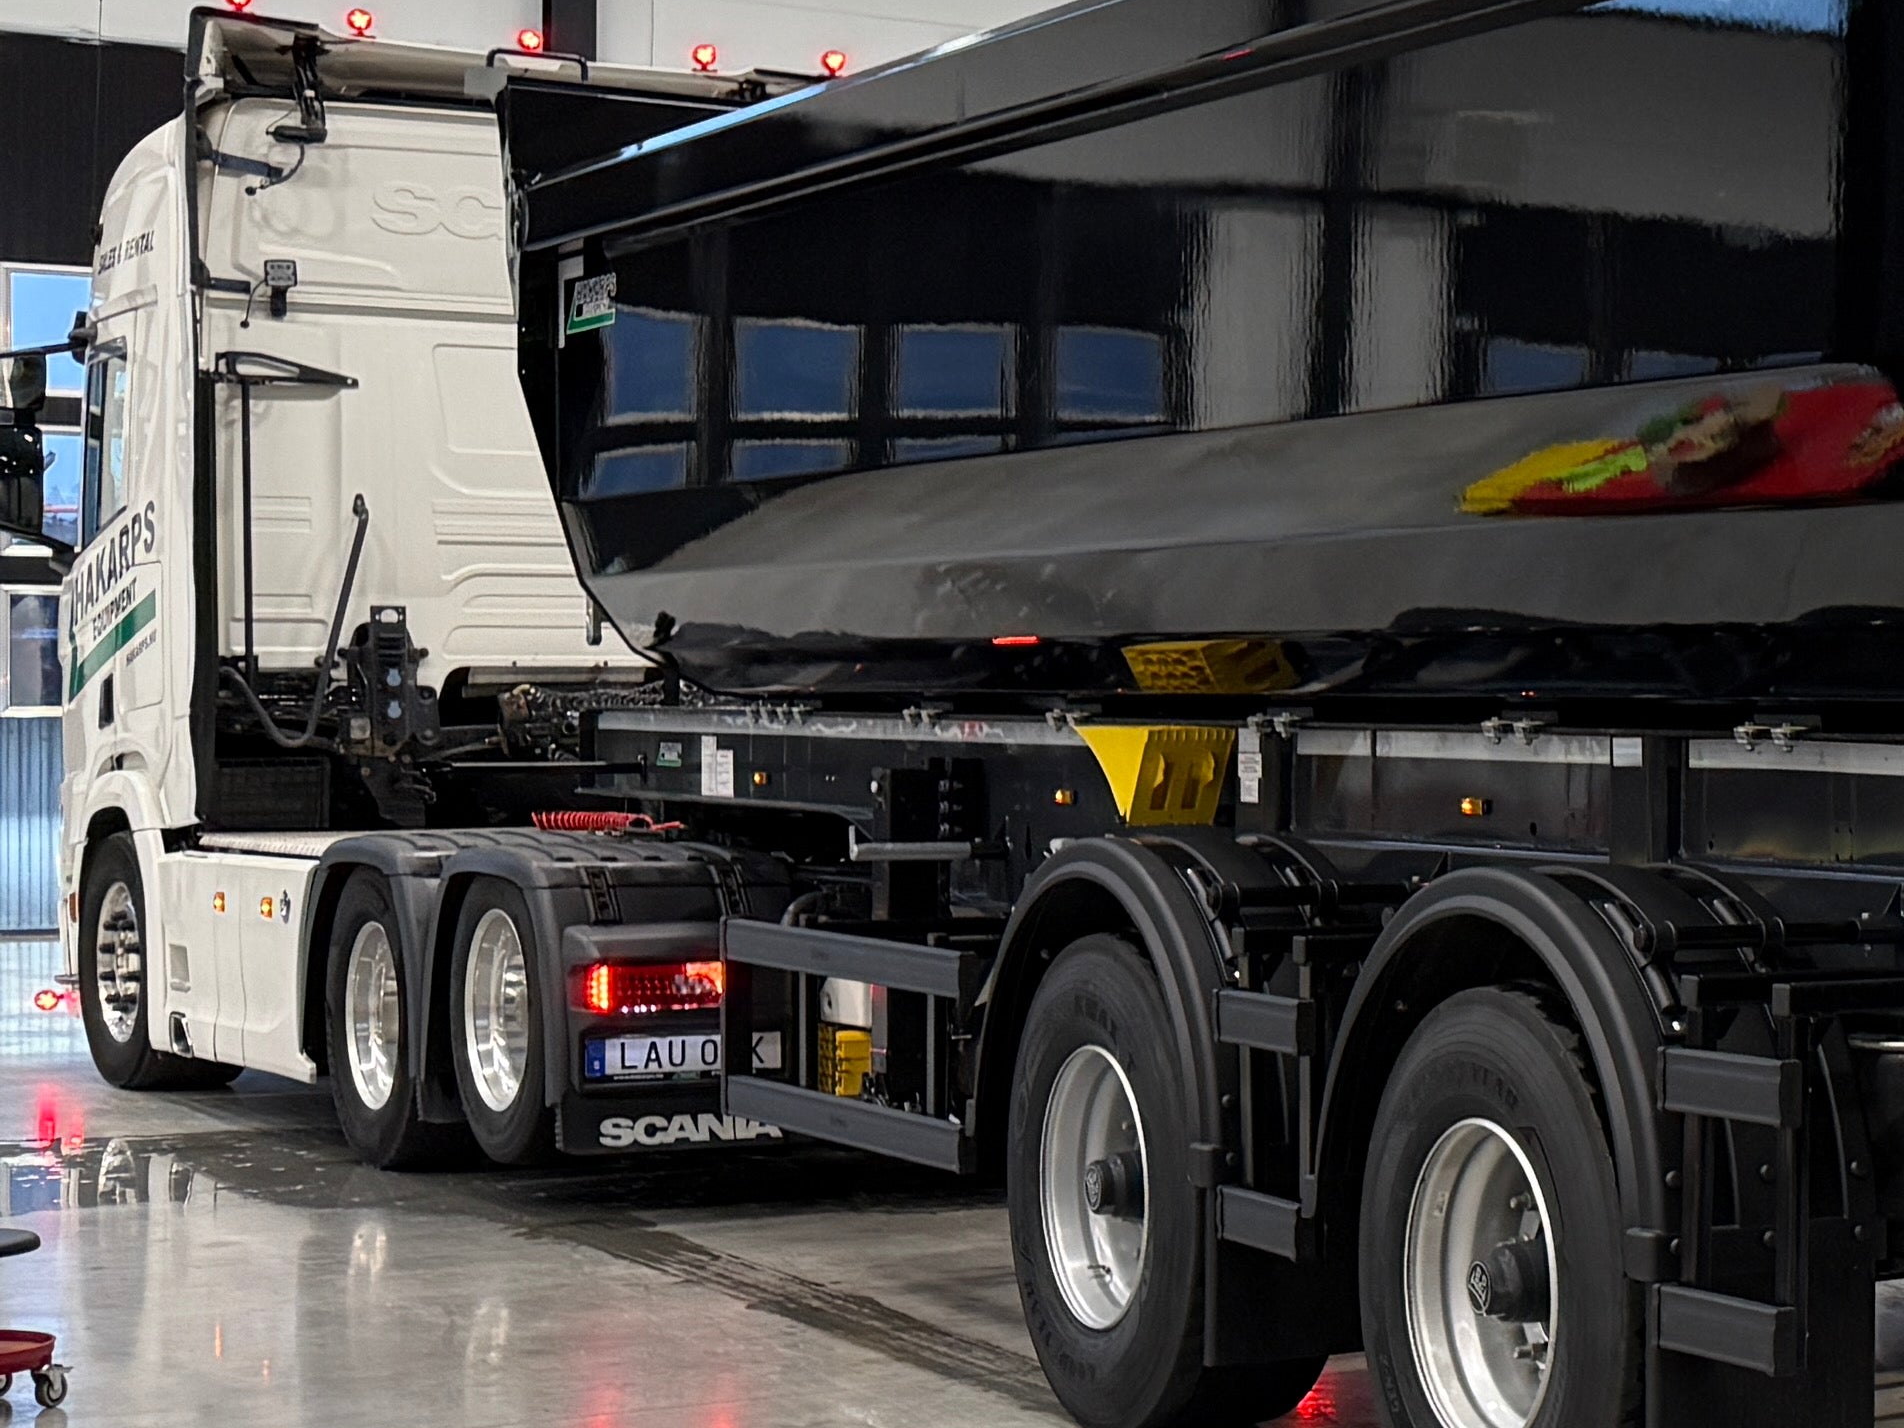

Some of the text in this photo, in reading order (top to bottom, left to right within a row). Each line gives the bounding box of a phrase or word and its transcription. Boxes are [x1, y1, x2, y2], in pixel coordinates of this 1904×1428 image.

[124, 230, 155, 262] RENTAL
[74, 500, 155, 625] HAKARPS
[92, 576, 138, 642] EQUIPMENT
[620, 1038, 687, 1071] LAU
[599, 1113, 783, 1148] SCANIA
